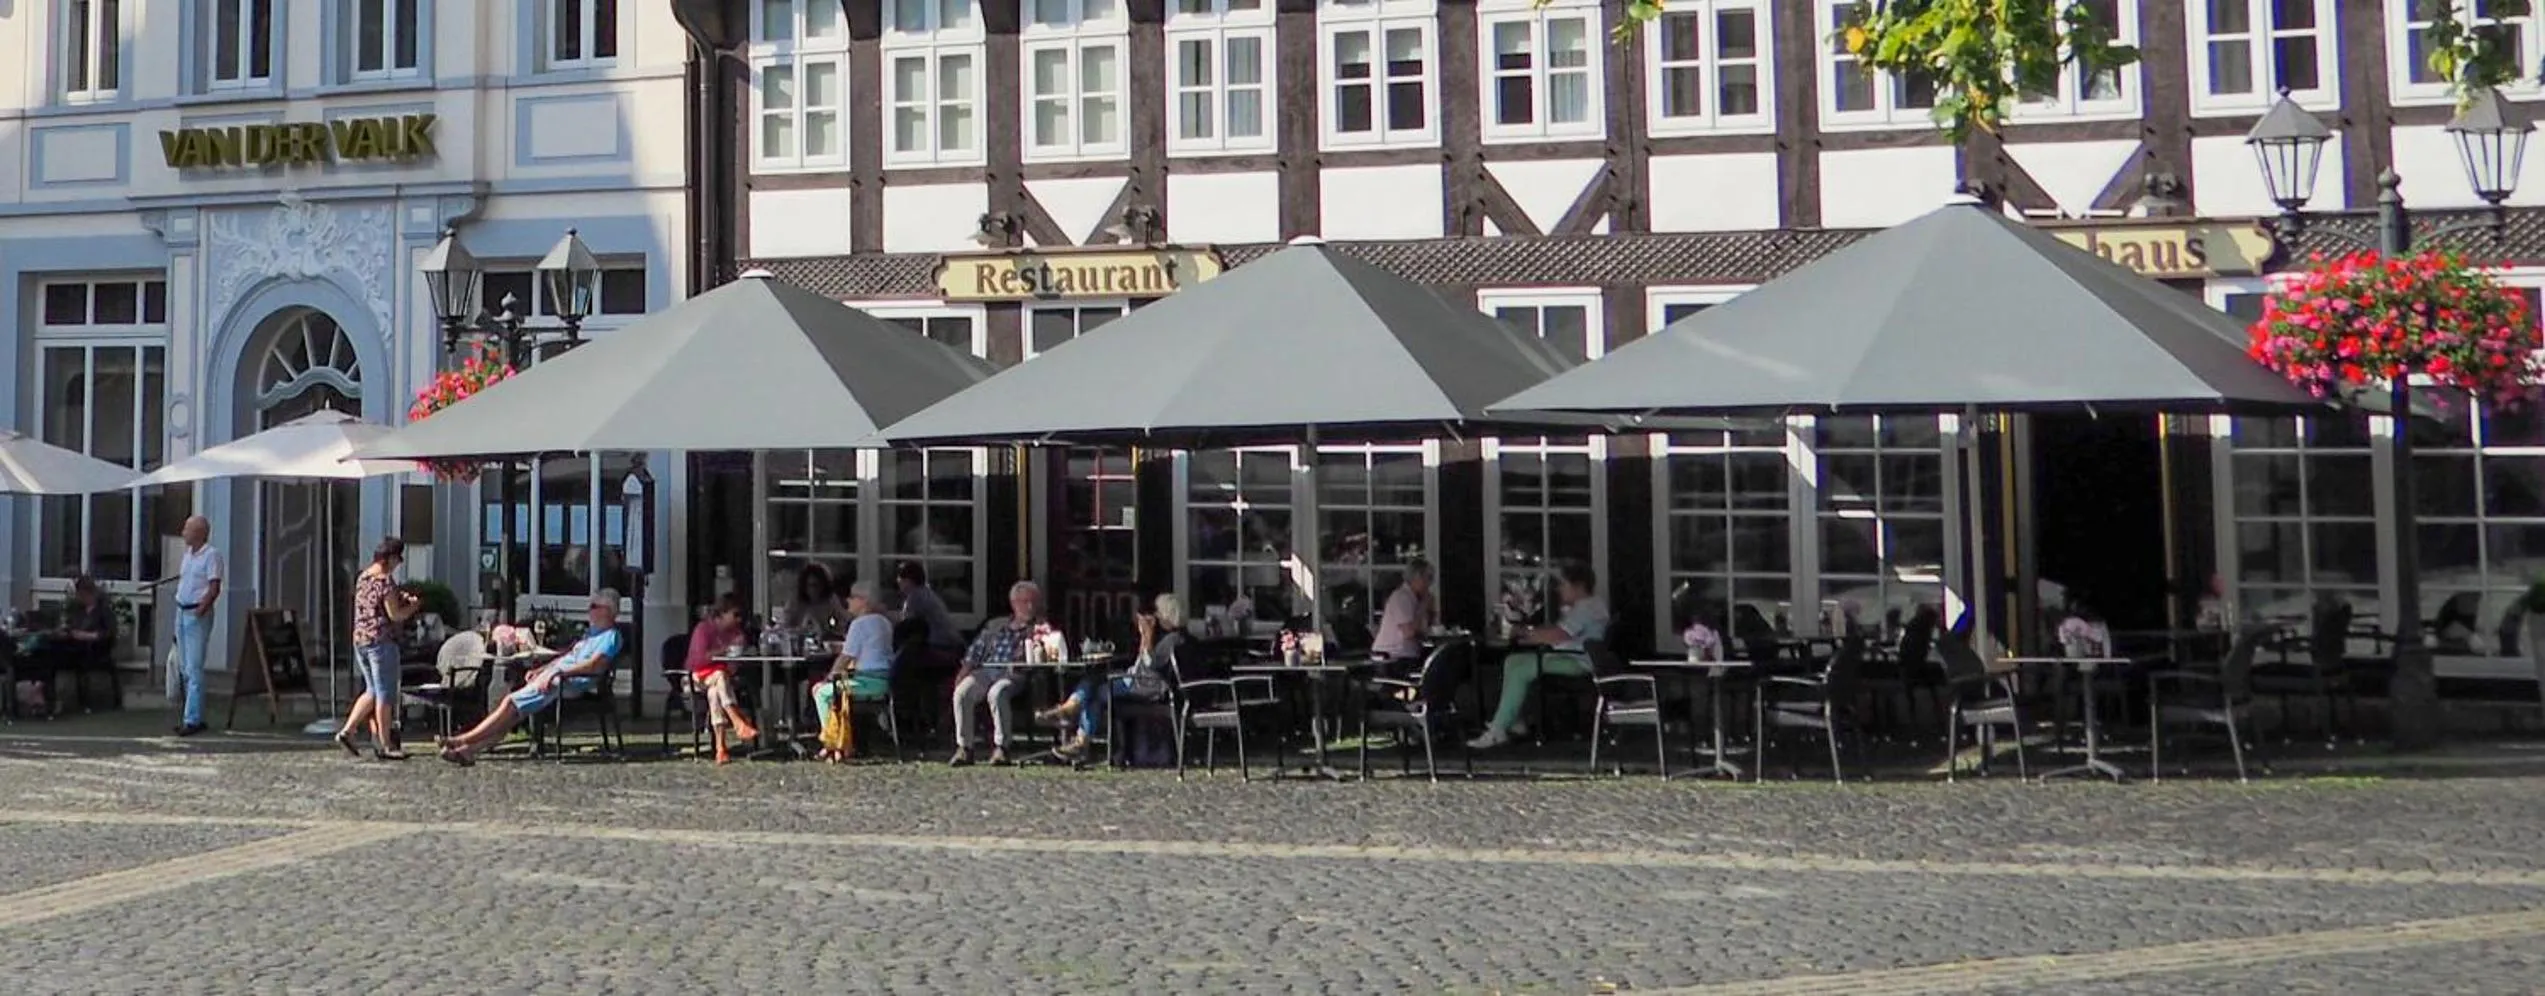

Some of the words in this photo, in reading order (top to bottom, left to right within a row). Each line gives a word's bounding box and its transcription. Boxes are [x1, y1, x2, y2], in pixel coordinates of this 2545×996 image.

[158, 127, 242, 168] VAN
[245, 123, 331, 166] DER
[331, 114, 438, 159] VALK
[975, 258, 1180, 294] Restaurant
